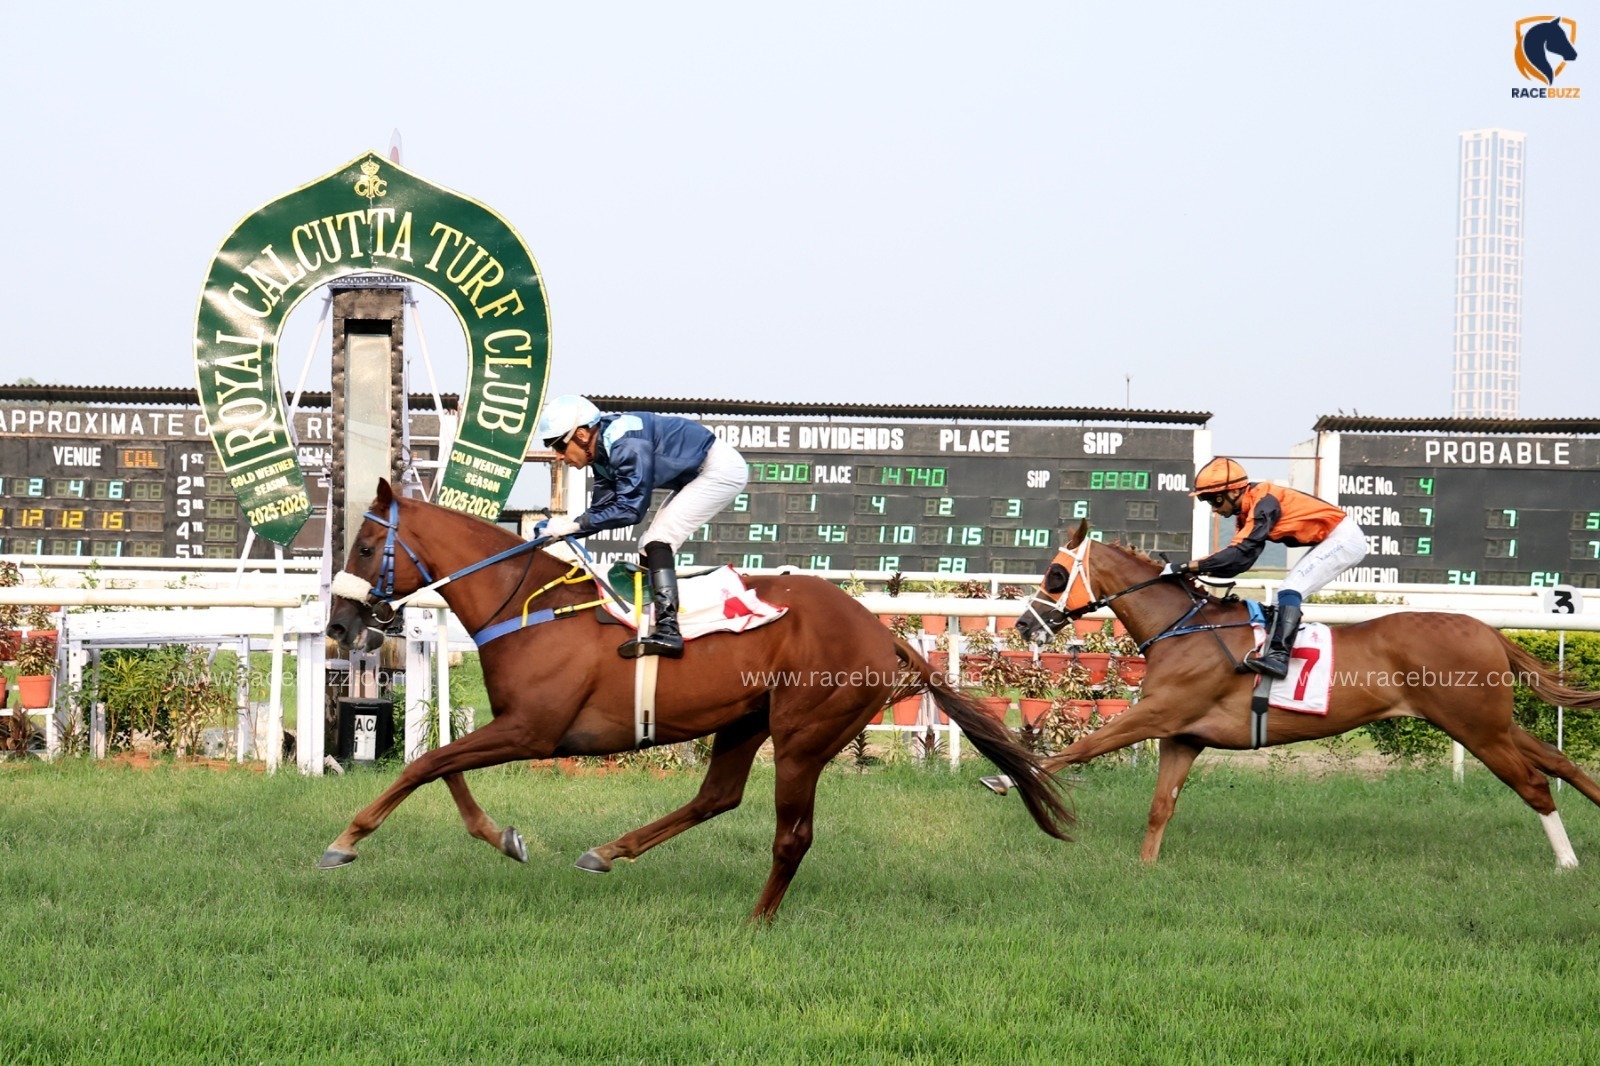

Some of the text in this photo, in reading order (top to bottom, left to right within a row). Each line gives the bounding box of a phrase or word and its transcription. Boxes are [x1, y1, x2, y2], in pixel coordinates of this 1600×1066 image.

[215, 207, 533, 457] ROYAL CALCUTTA TURF CLUB
[0, 409, 184, 436] APPROXIMATE
[799, 426, 905, 451] DIVIDENDS
[939, 429, 1010, 453] PLACE
[1082, 431, 1124, 455] SHP
[53, 445, 159, 468] VENUE CAL
[450, 449, 512, 480] COLD WEATHER
[1425, 440, 1570, 465] PROBABLE
[230, 458, 296, 489] COLD WEATHER
[464, 472, 501, 494] SEASON
[815, 464, 852, 484] PLACE
[882, 466, 945, 488] 14740
[1026, 469, 1050, 489] SHP
[1157, 472, 1190, 492] POOL
[1339, 475, 1434, 496] RACE No. 4
[28, 478, 124, 499] 2 4 6
[254, 476, 289, 497] SEASON
[247, 491, 309, 527] 2025-2026
[438, 485, 501, 520] 2025-2026
[733, 494, 1088, 519] 5 1 4 2 3 6
[62, 510, 84, 528] 12
[102, 511, 124, 529] 15
[1383, 507, 1402, 526] No.
[1419, 508, 1432, 526] 7
[1503, 509, 1516, 527] 7
[612, 524, 637, 542] DIV.
[748, 524, 777, 542] 24
[1014, 529, 1050, 547] 140
[1381, 536, 1401, 556] No.
[1417, 538, 1432, 555] 5
[1509, 540, 1515, 557] 1
[1531, 572, 1560, 587] 64
[1291, 647, 1320, 701] 7
[355, 718, 377, 732] AC
